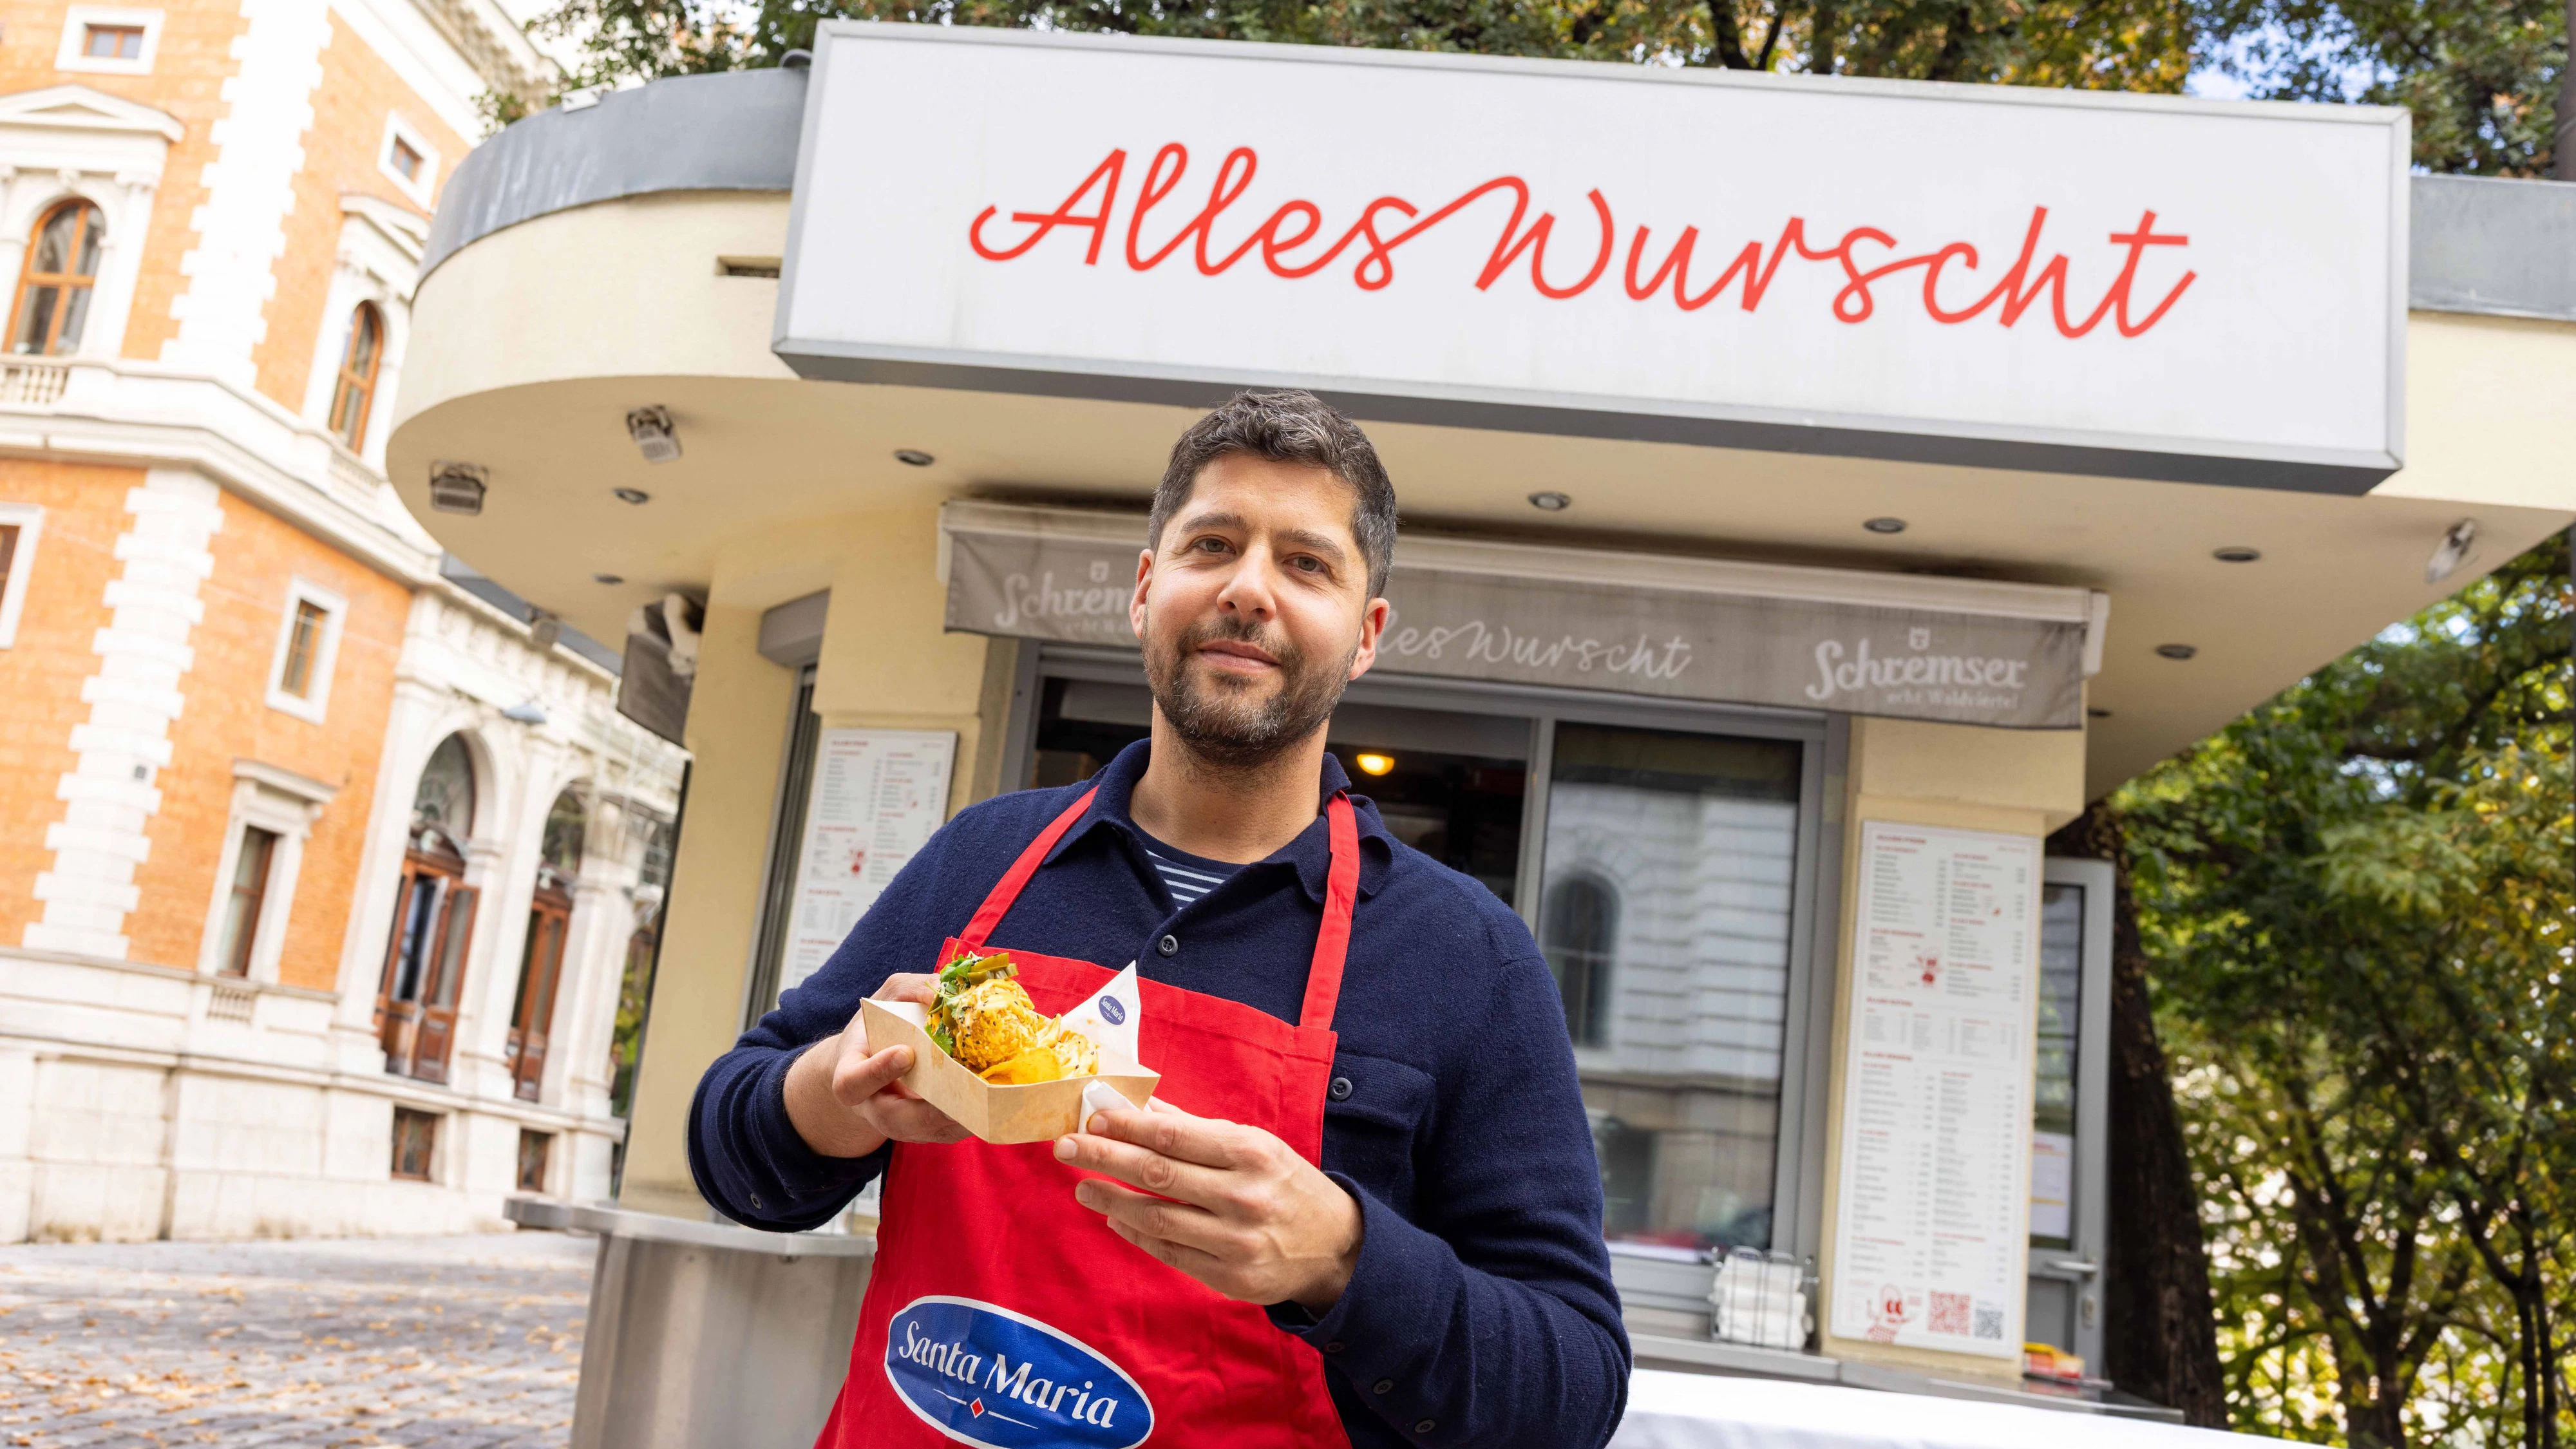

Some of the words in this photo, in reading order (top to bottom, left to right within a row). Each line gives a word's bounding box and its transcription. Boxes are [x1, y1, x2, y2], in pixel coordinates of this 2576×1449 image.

[970, 142, 1419, 292] Alles
[1423, 175, 2197, 339] Wurscht
[994, 571, 1135, 629] Schrem
[1452, 620, 1692, 679] Wurscht
[1804, 637, 2029, 701] Schremser
[1101, 998, 1113, 1012] Santa
[1110, 1006, 1124, 1022] Maria
[898, 1320, 981, 1385] Santa
[984, 1353, 1119, 1428] Maria
